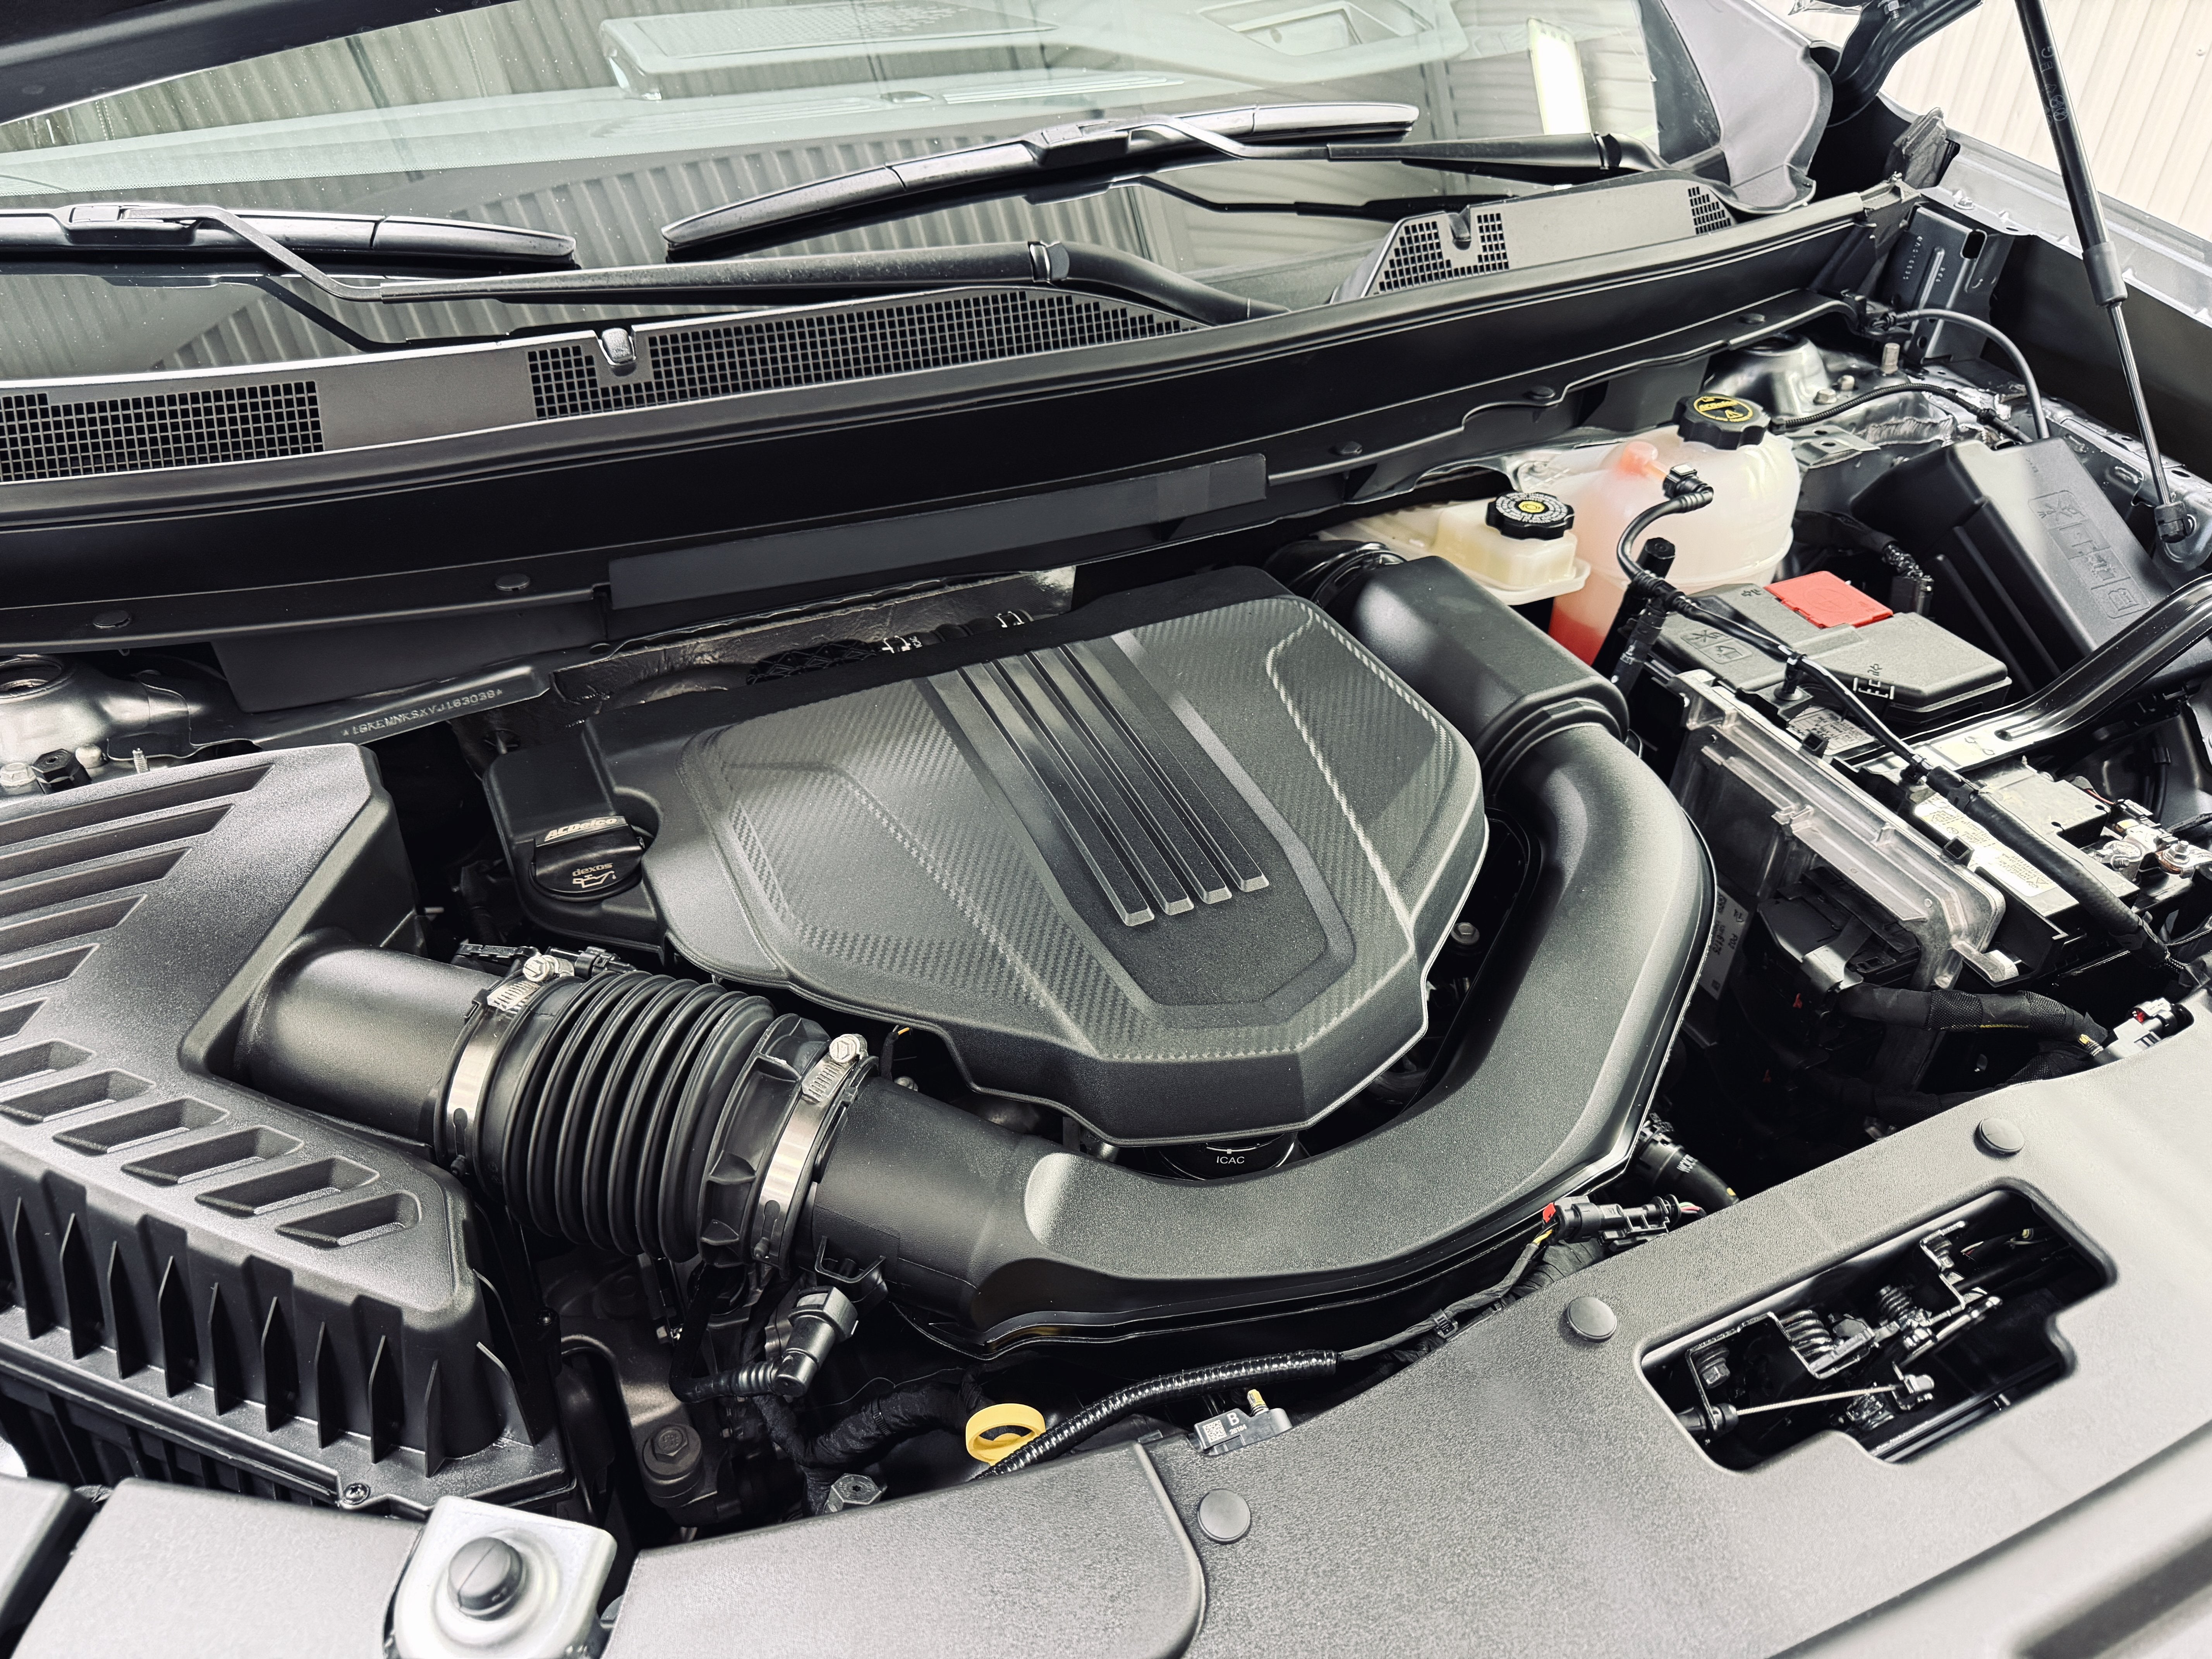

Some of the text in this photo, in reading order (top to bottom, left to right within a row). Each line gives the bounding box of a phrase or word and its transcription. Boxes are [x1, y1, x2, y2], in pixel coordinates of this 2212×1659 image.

[545, 817, 617, 840] ACDelco
[572, 863, 613, 876] dexos
[1216, 1156, 1245, 1164] ICAC
[1227, 1412, 1240, 1426] B
